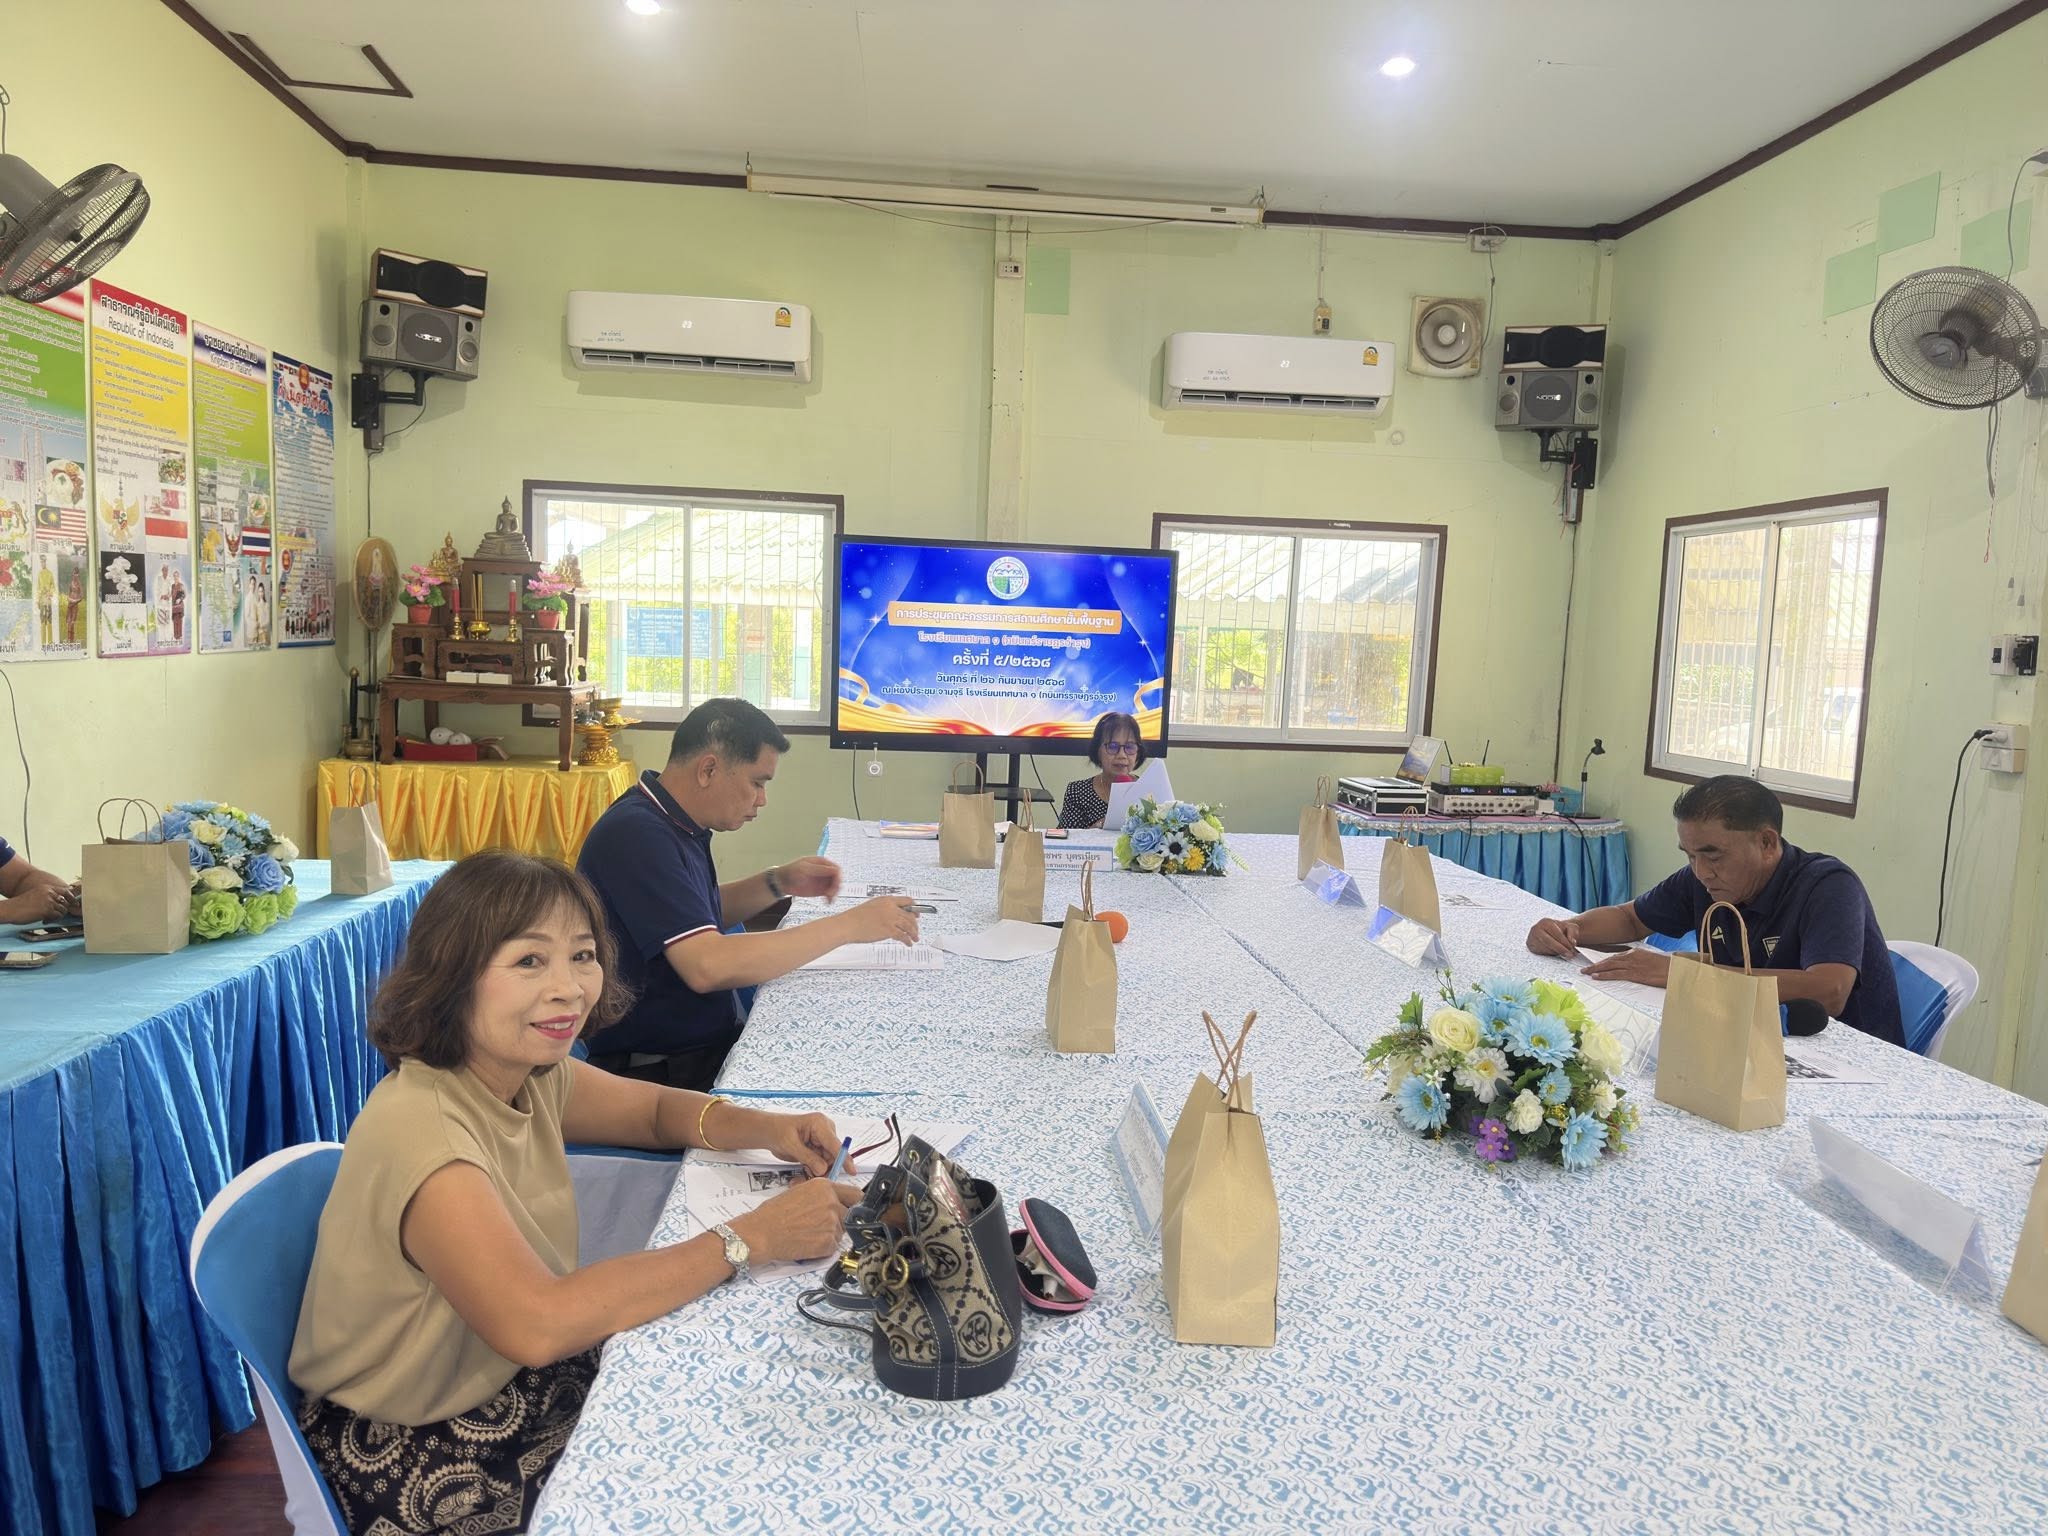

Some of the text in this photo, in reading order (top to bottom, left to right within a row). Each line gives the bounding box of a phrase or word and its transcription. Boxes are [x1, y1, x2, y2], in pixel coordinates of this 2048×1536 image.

[100, 295, 180, 335] สาธารณรัฐอินโดนีเซีย
[108, 316, 174, 349] Republic of Indonesia
[1280, 360, 1290, 368] 23
[896, 608, 1114, 628] การประชุมคณะกรรมการสถานศึกษาขั้นพื้นฐาน
[918, 630, 990, 645] โรงเรียนเทศบาล
[953, 648, 1051, 668] ครั้งที่ ๕/๒๕๖๘
[936, 671, 1065, 686] วันศุกร์ ที่ ๒๖ กันยายน ๒๕๖๘
[882, 686, 891, 694] ณ
[893, 684, 935, 697] ห้องประชุม
[938, 688, 964, 698] จามจุรี
[966, 687, 1028, 697] โรงเรียนเทศบาล
